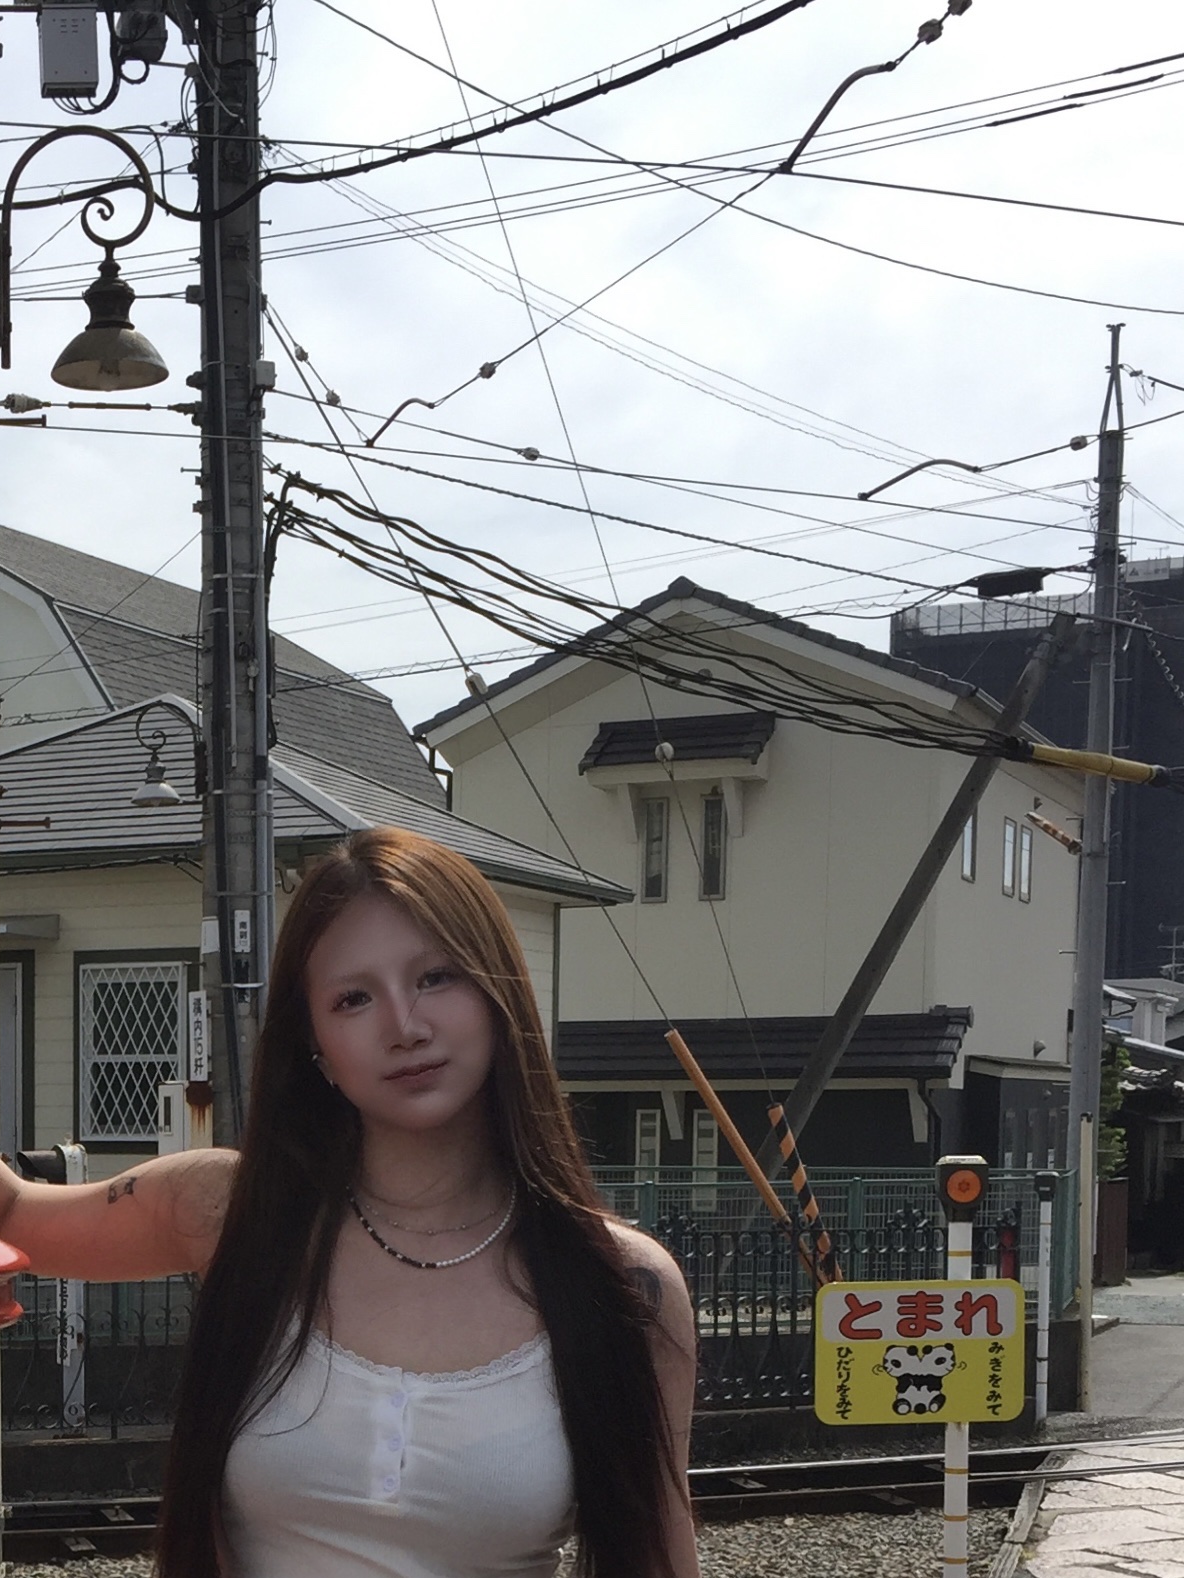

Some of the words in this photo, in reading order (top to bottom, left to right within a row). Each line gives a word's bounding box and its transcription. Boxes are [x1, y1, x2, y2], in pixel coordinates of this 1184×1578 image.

[838, 1290, 1003, 1340] とまれ
[835, 1346, 855, 1420] ひだりをみて
[985, 1341, 1006, 1416] みぎをみて
